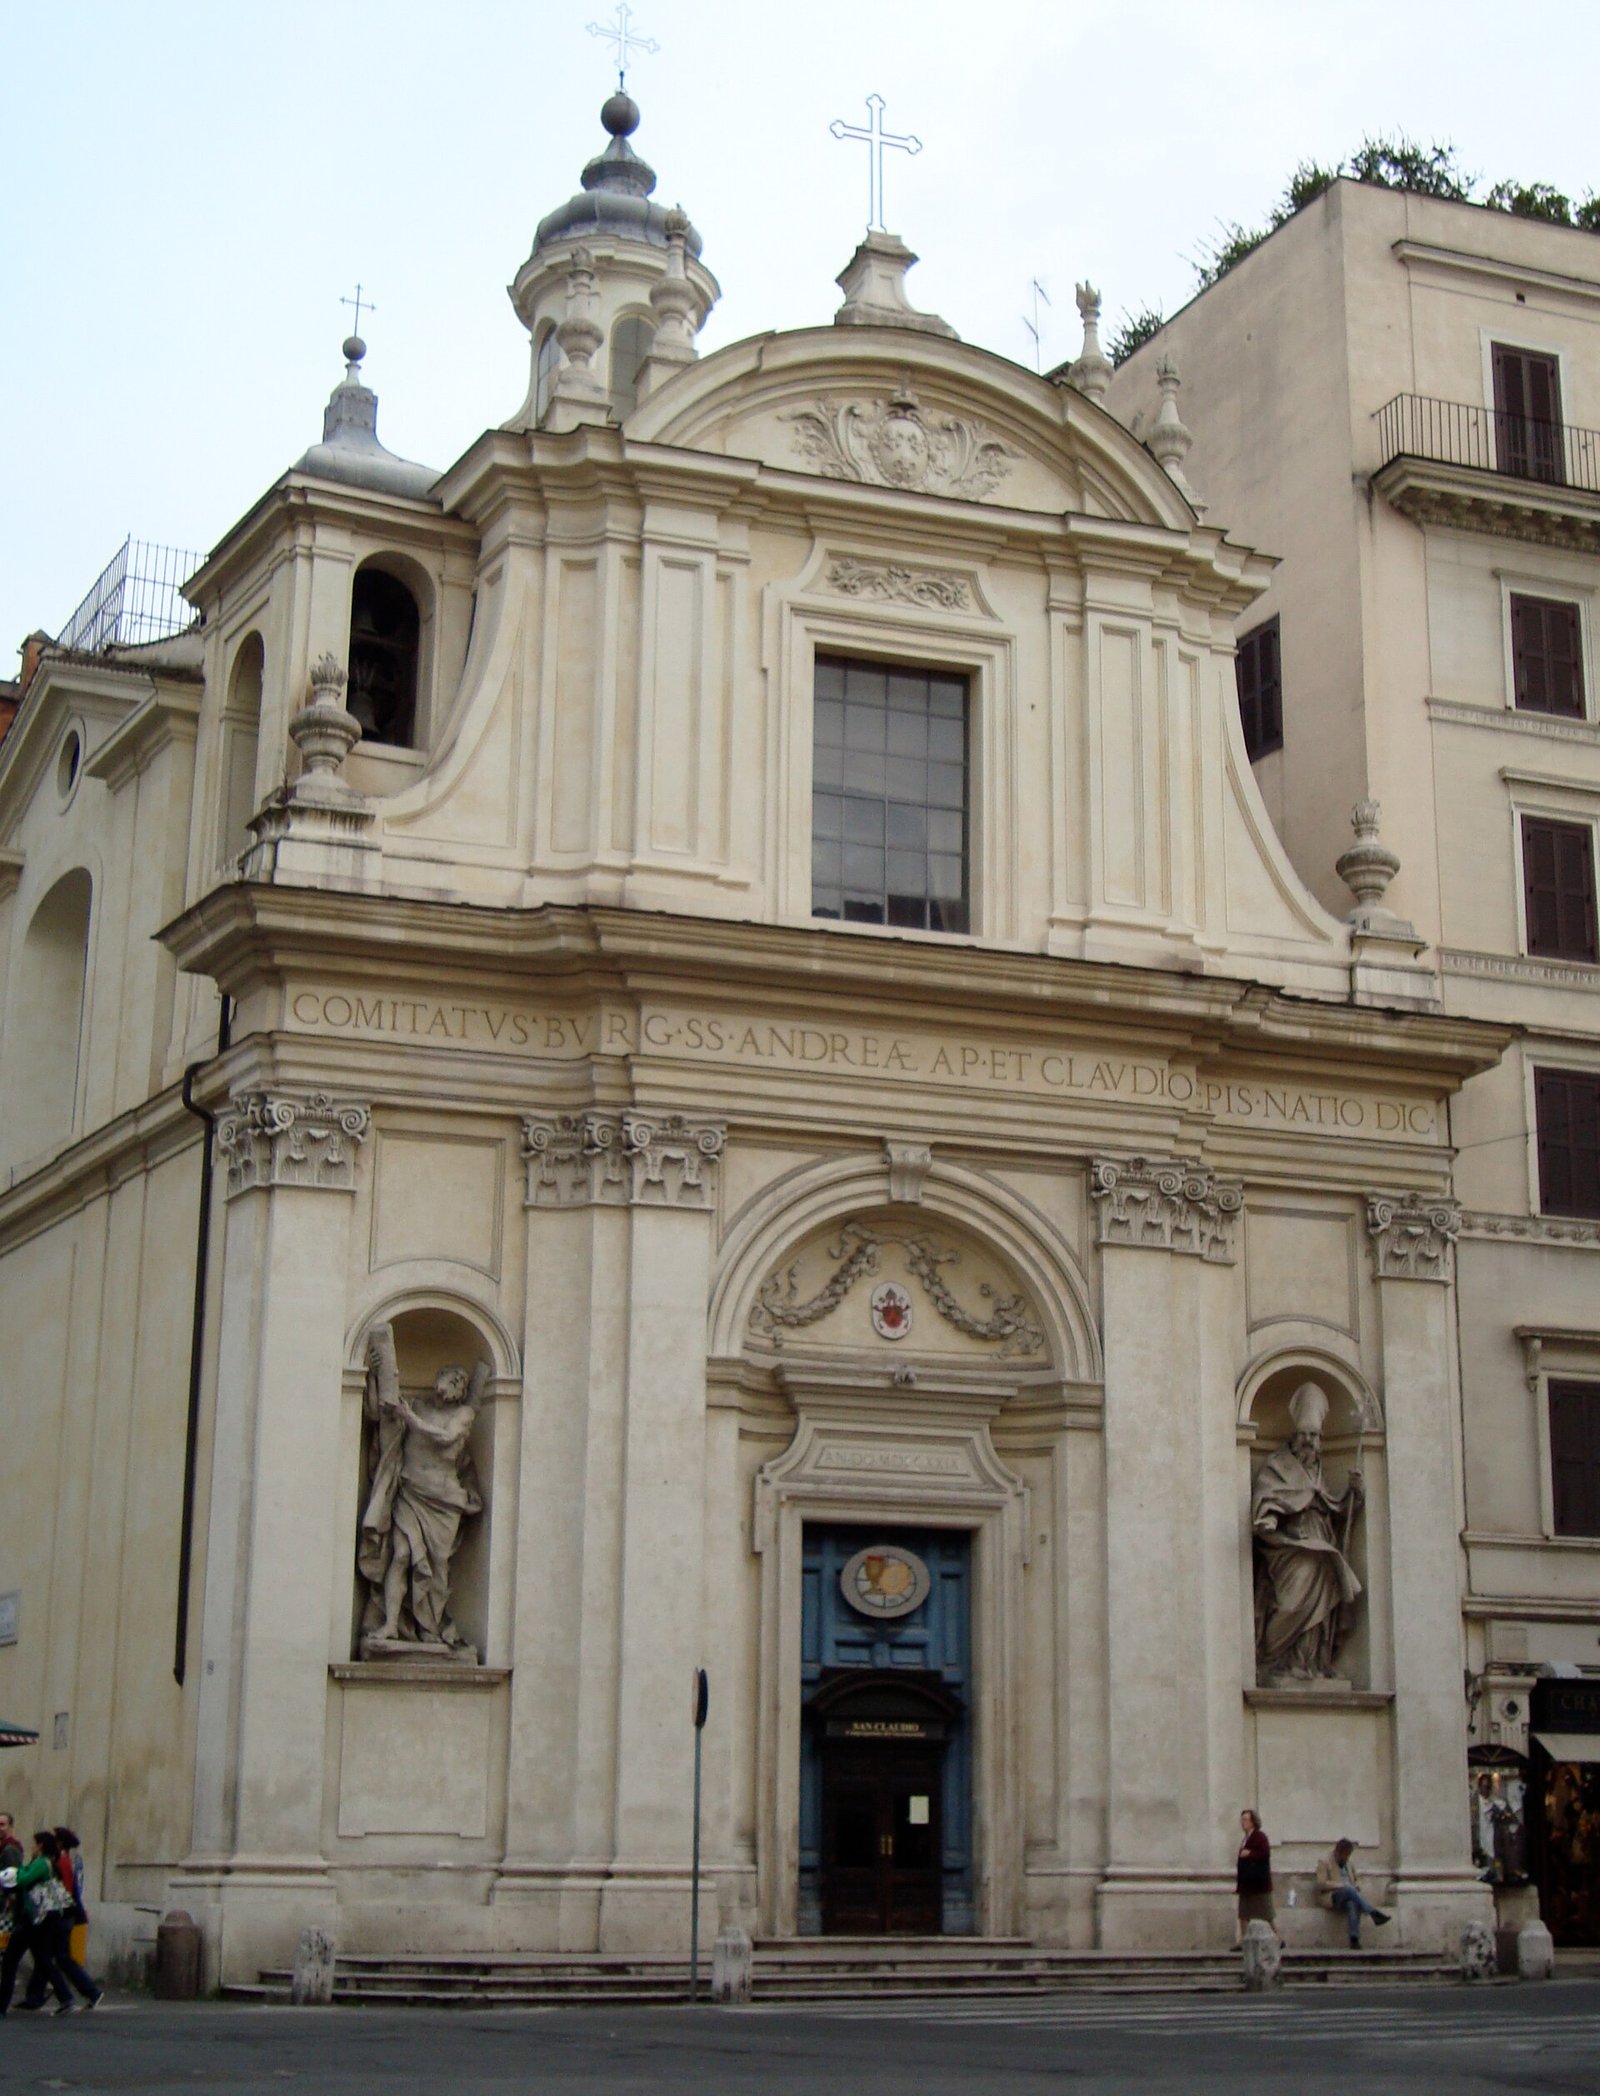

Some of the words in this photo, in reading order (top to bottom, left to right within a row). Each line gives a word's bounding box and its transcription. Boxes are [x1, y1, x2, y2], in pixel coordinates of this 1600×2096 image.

[292, 992, 529, 1046] COMITATVS
[989, 1049, 1032, 1082] ET
[1040, 1056, 1193, 1102] CLAVDIO
[1263, 1089, 1364, 1127] NATIO
[852, 1722, 873, 1732] SAN
[874, 1722, 920, 1732] CLAUDIO
